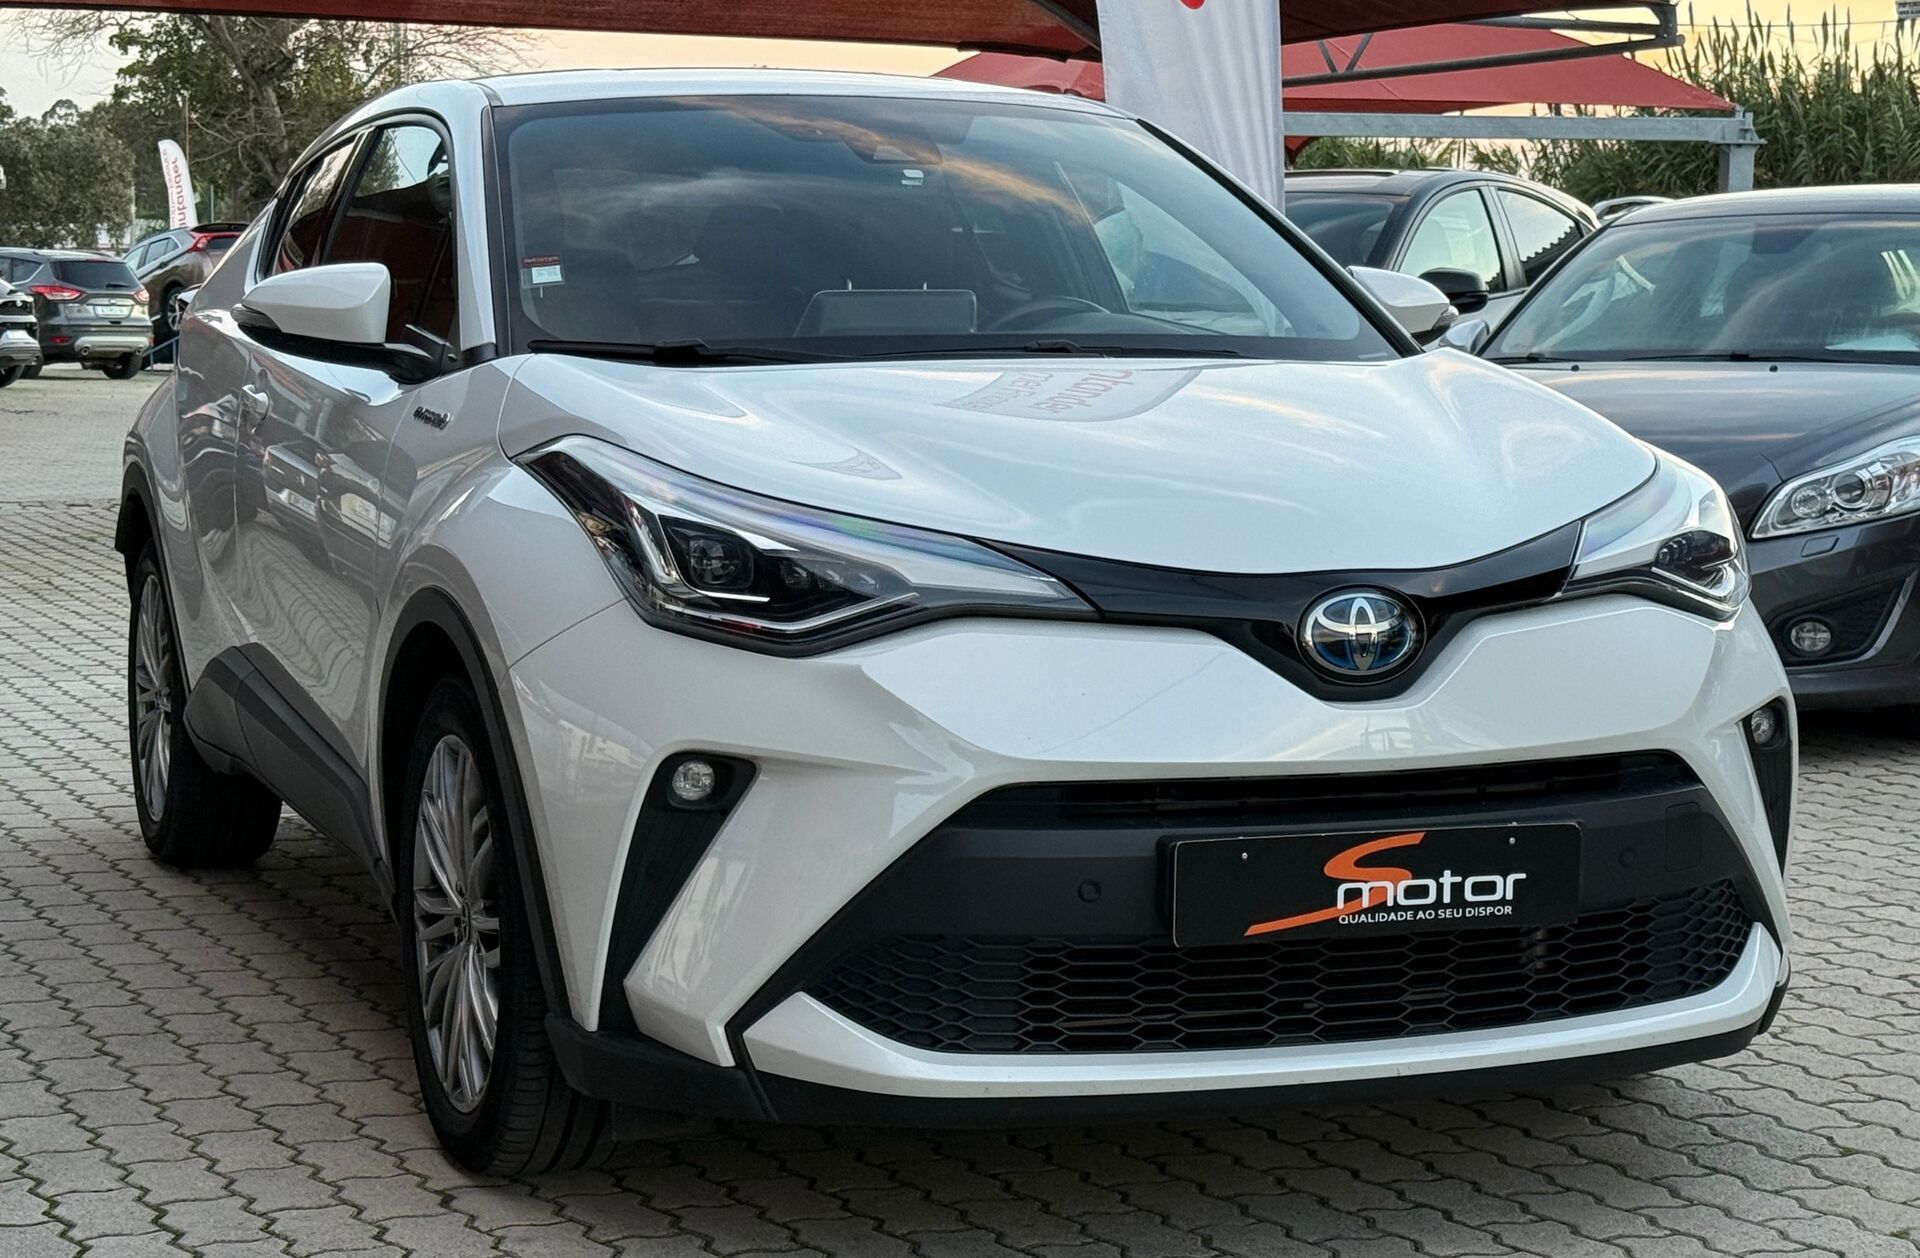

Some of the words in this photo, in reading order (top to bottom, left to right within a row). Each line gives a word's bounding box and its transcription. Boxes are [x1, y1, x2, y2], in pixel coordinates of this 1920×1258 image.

[1338, 911, 1415, 925] QUALIDADE
[1416, 910, 1435, 920] AO
[1437, 908, 1463, 919] SEU
[1465, 905, 1513, 917] DISPOR
